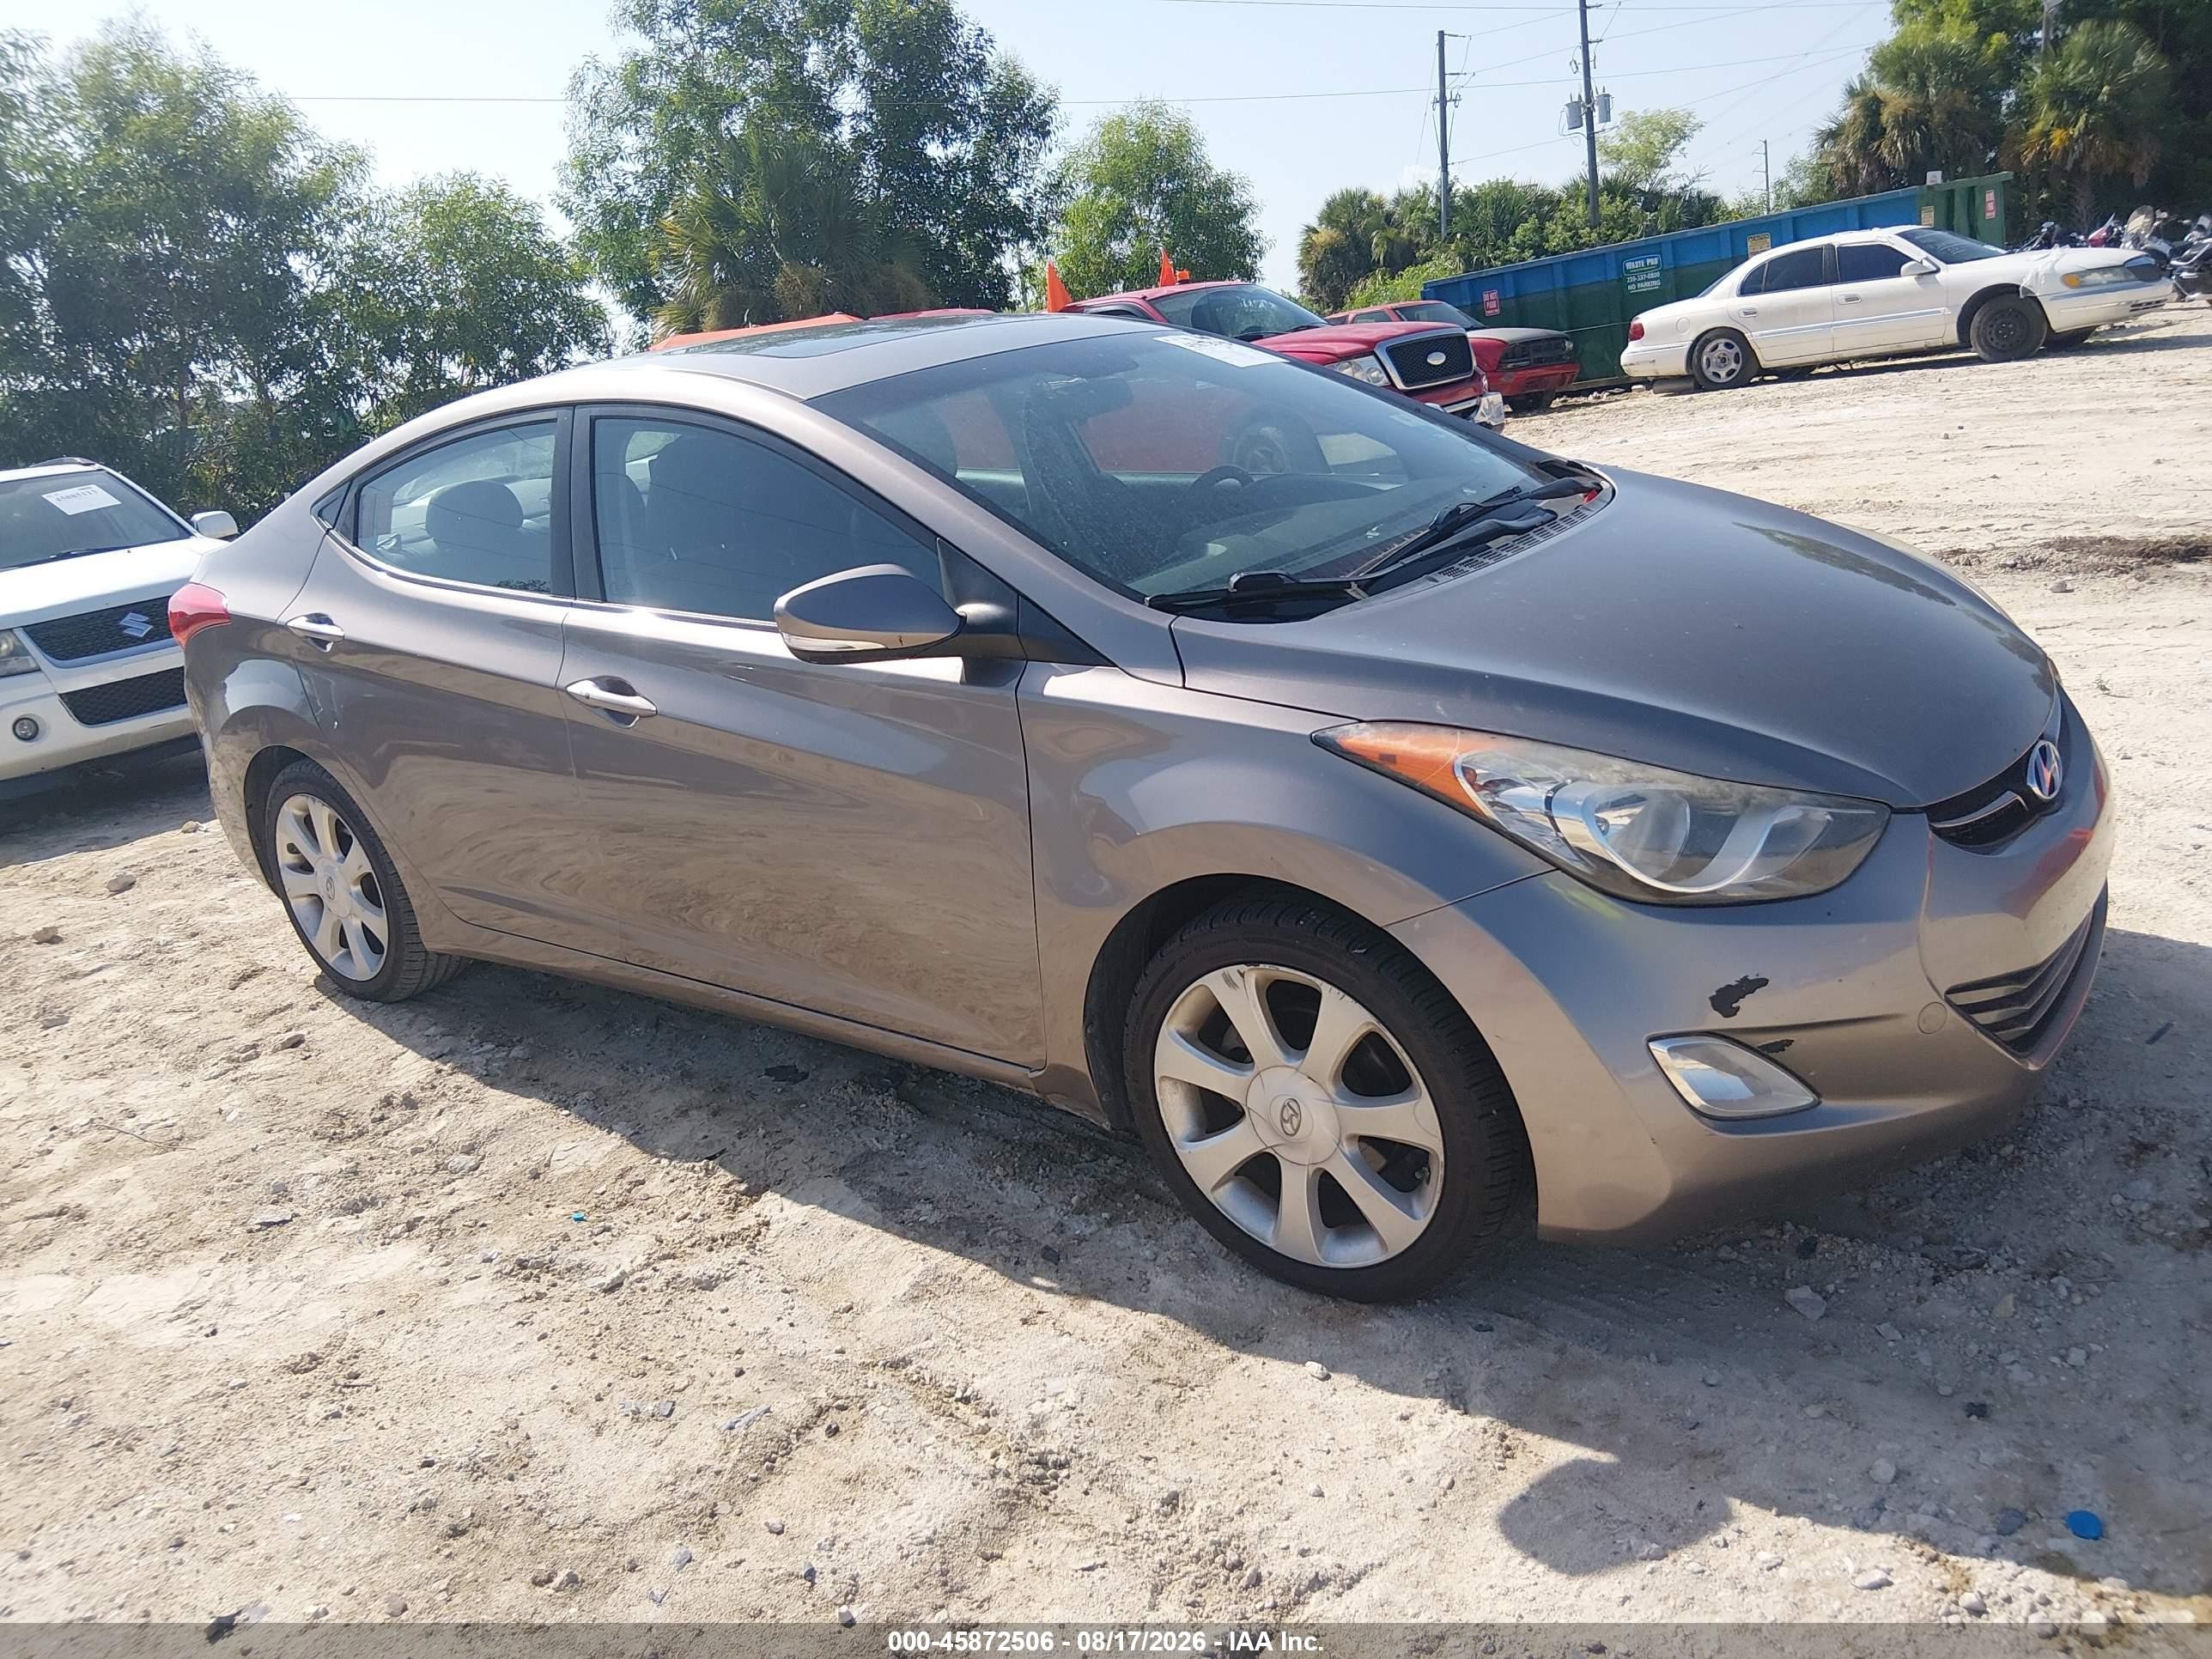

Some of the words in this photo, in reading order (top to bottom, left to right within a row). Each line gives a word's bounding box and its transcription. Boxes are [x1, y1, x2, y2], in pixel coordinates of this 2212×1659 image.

[1626, 259, 1645, 270] WASTE
[1646, 258, 1658, 266] PRO
[1637, 279, 1661, 289] PARKING
